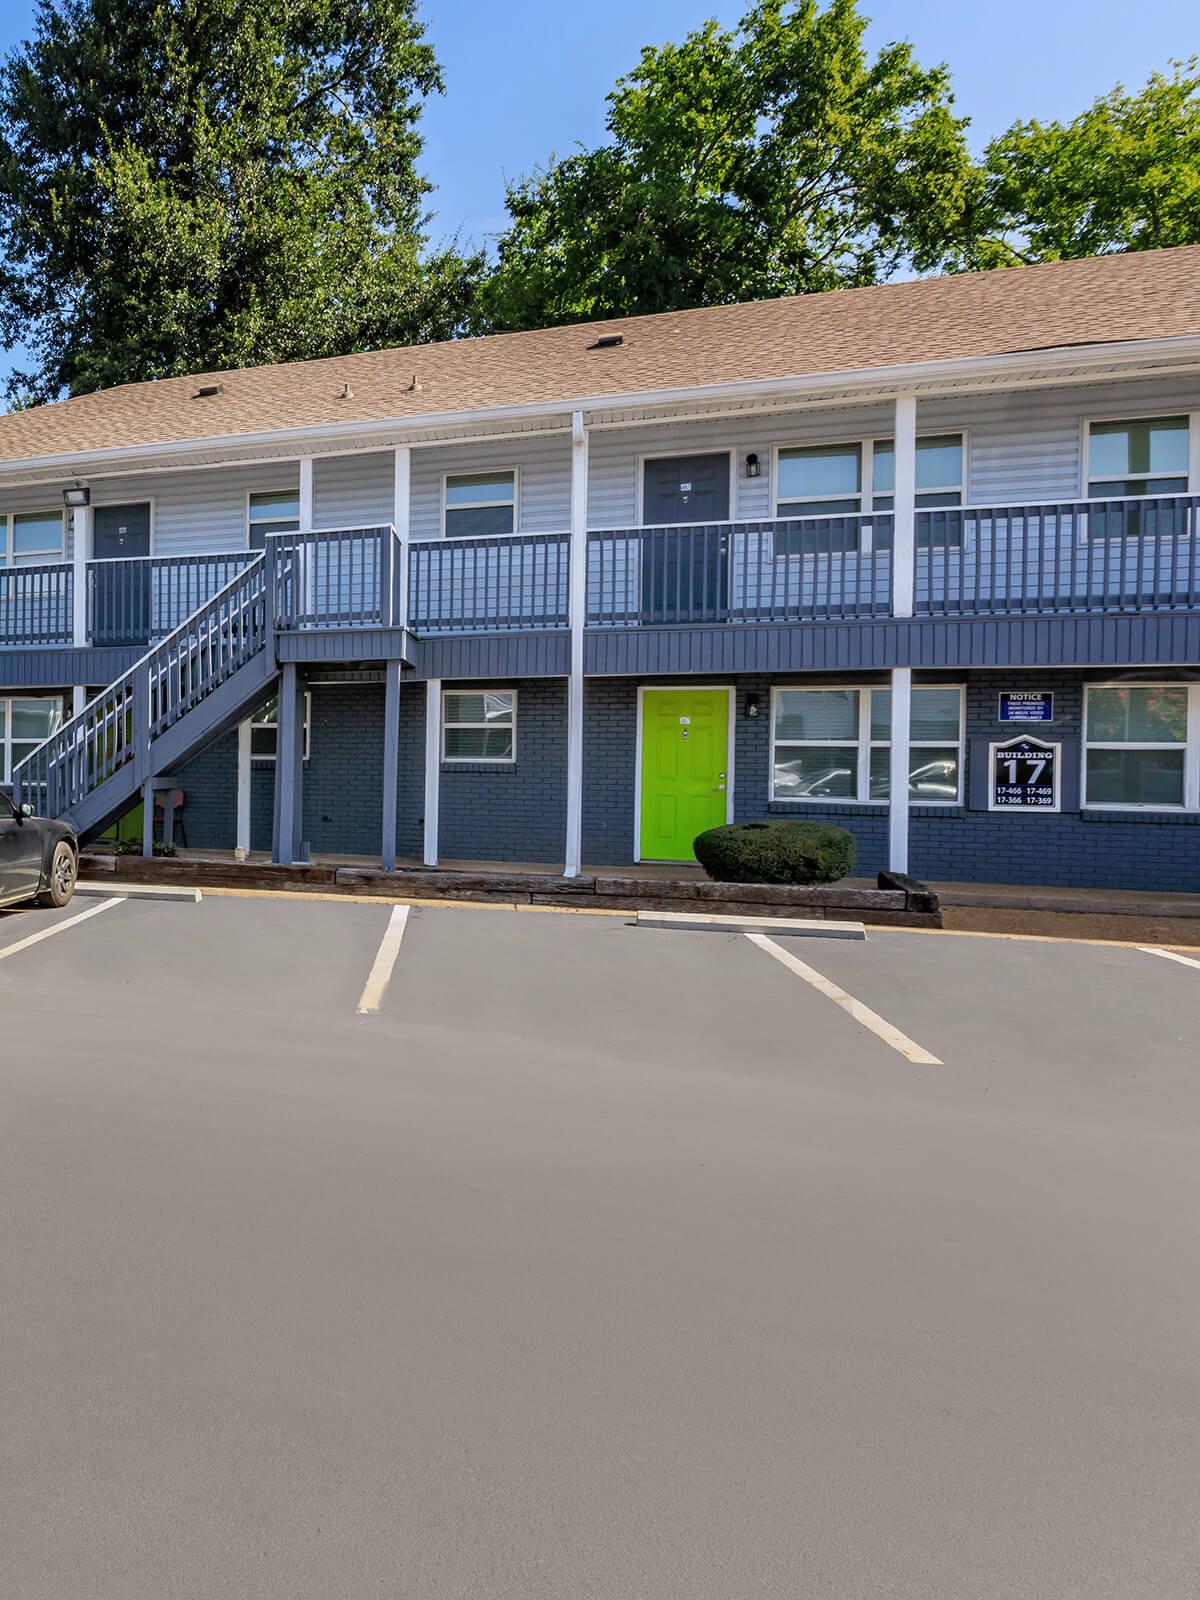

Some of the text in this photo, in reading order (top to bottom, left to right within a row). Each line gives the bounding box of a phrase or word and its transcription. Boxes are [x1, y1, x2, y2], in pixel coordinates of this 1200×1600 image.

[1003, 759, 1047, 784] 17
[997, 787, 1052, 795] 17-466 17-469
[997, 796, 1052, 804] 17-366 17-369
